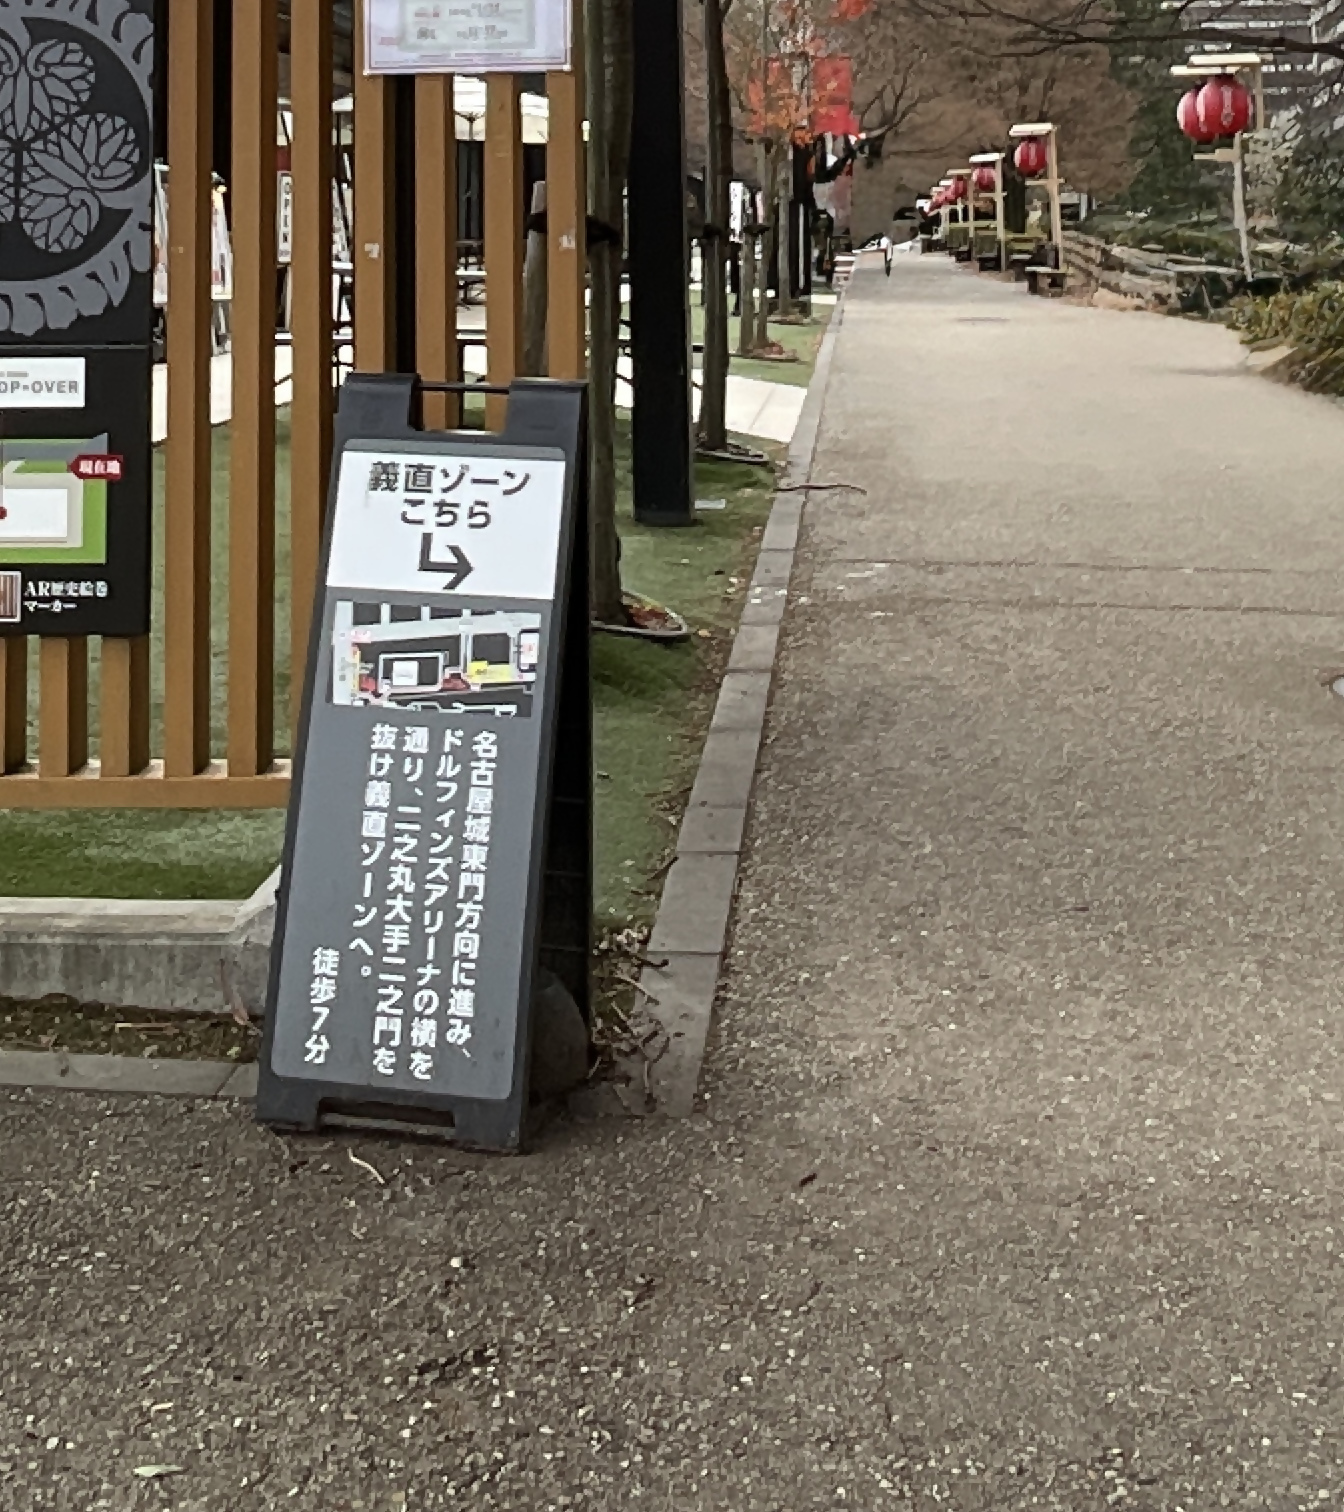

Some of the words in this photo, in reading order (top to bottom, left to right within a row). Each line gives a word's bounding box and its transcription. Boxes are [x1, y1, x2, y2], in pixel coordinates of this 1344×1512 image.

[368, 461, 531, 496] 義直ゾーン
[401, 499, 492, 530] こちら
[348, 723, 398, 977] 抜け義直ゾーンへ。
[372, 726, 430, 1075] 通り、二之丸大手二之門を
[408, 729, 464, 1080] ドルフィンズアリーナの横を
[445, 730, 498, 1059] 名古屋城東門方向に進み、
